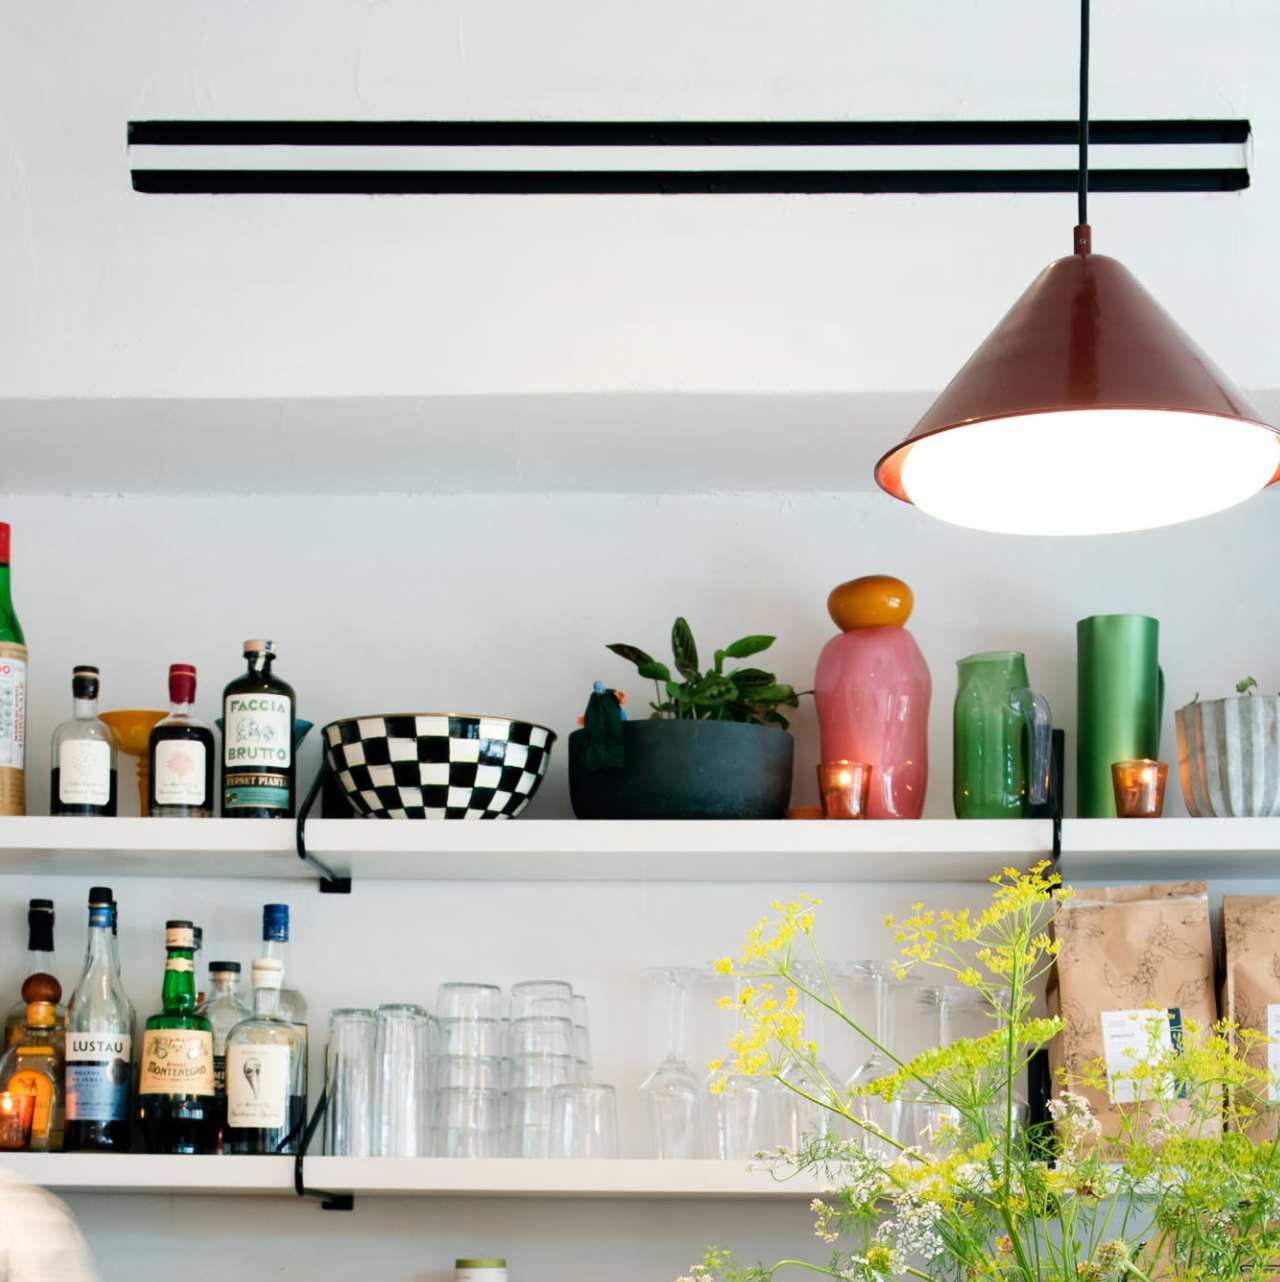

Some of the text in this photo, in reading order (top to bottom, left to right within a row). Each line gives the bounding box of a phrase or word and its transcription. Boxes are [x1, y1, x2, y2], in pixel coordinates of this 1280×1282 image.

[231, 700, 286, 713] FACCIA
[229, 747, 286, 760] BRUTTO
[73, 1040, 124, 1054] LUSTAU
